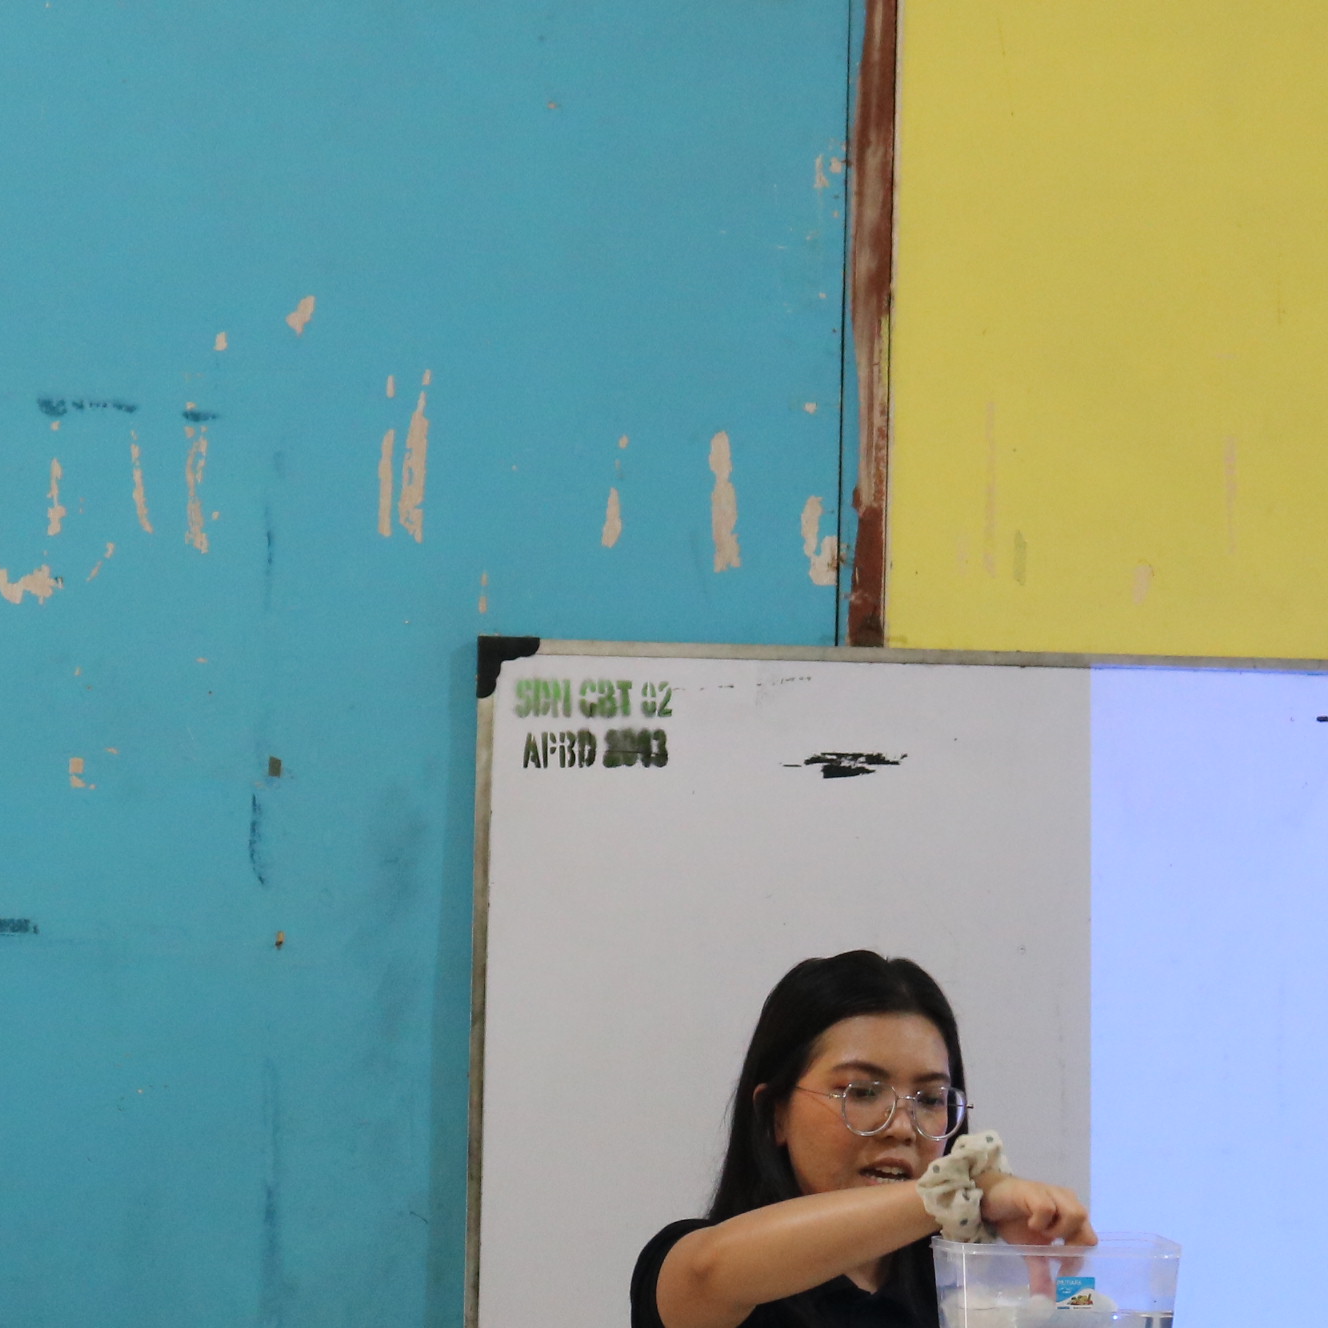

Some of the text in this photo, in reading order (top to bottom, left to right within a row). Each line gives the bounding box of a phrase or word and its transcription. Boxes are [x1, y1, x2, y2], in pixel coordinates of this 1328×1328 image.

[514, 676, 572, 719] SDN
[641, 680, 673, 718] 02
[522, 728, 597, 769] APBD
